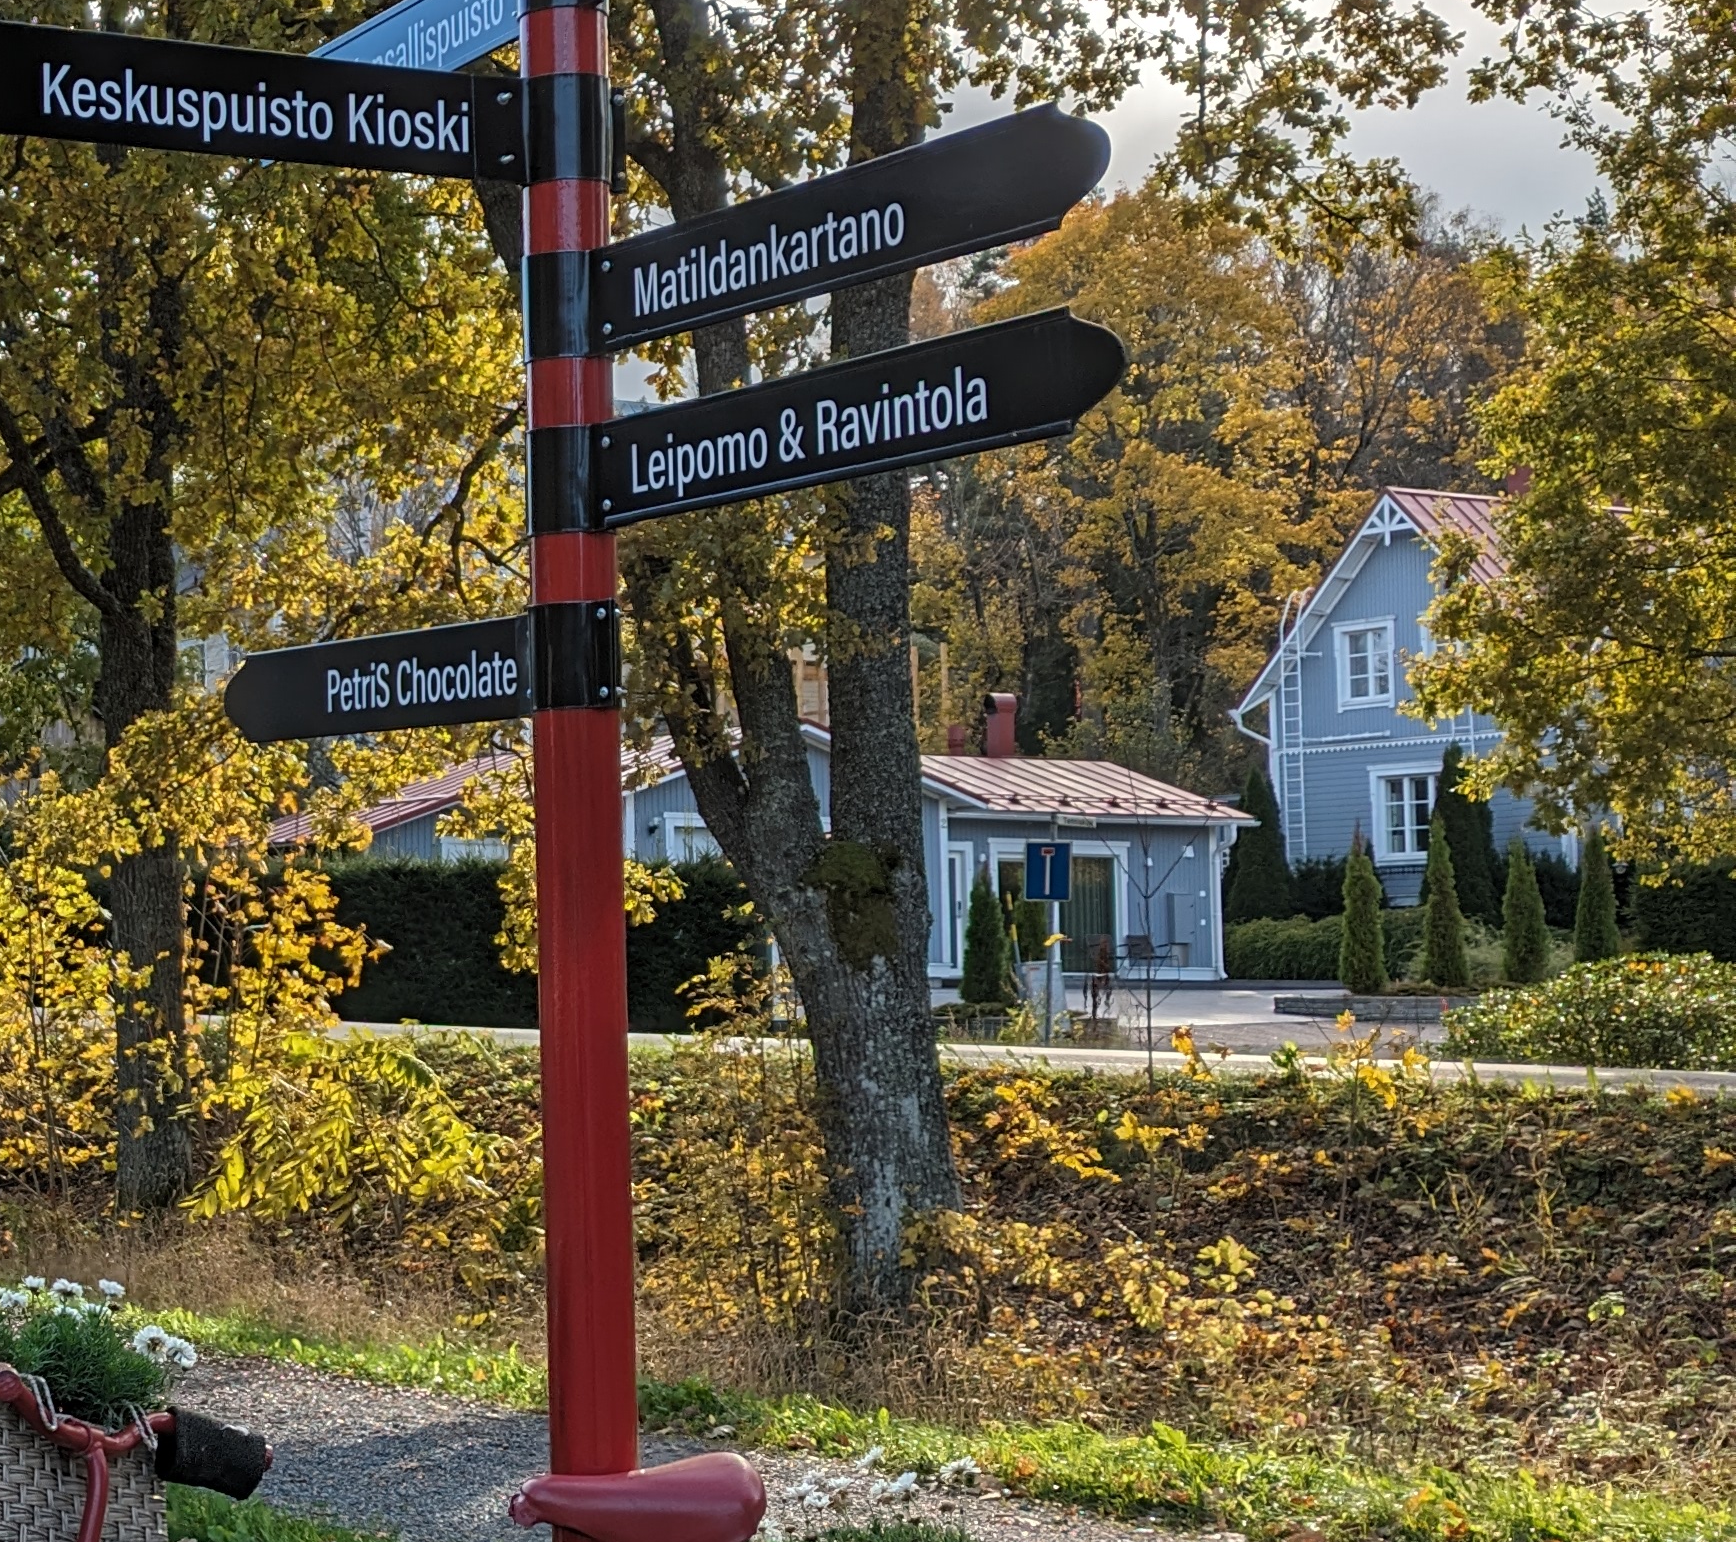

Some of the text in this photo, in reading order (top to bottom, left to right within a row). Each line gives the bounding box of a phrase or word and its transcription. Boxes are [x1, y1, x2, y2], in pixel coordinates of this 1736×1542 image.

[42, 62, 469, 153] Keskuspuisto Kioski
[633, 202, 905, 318] Matildankartano
[631, 365, 989, 498] Leipomo & Ravintola
[327, 649, 519, 713] PetriS Chocolate
